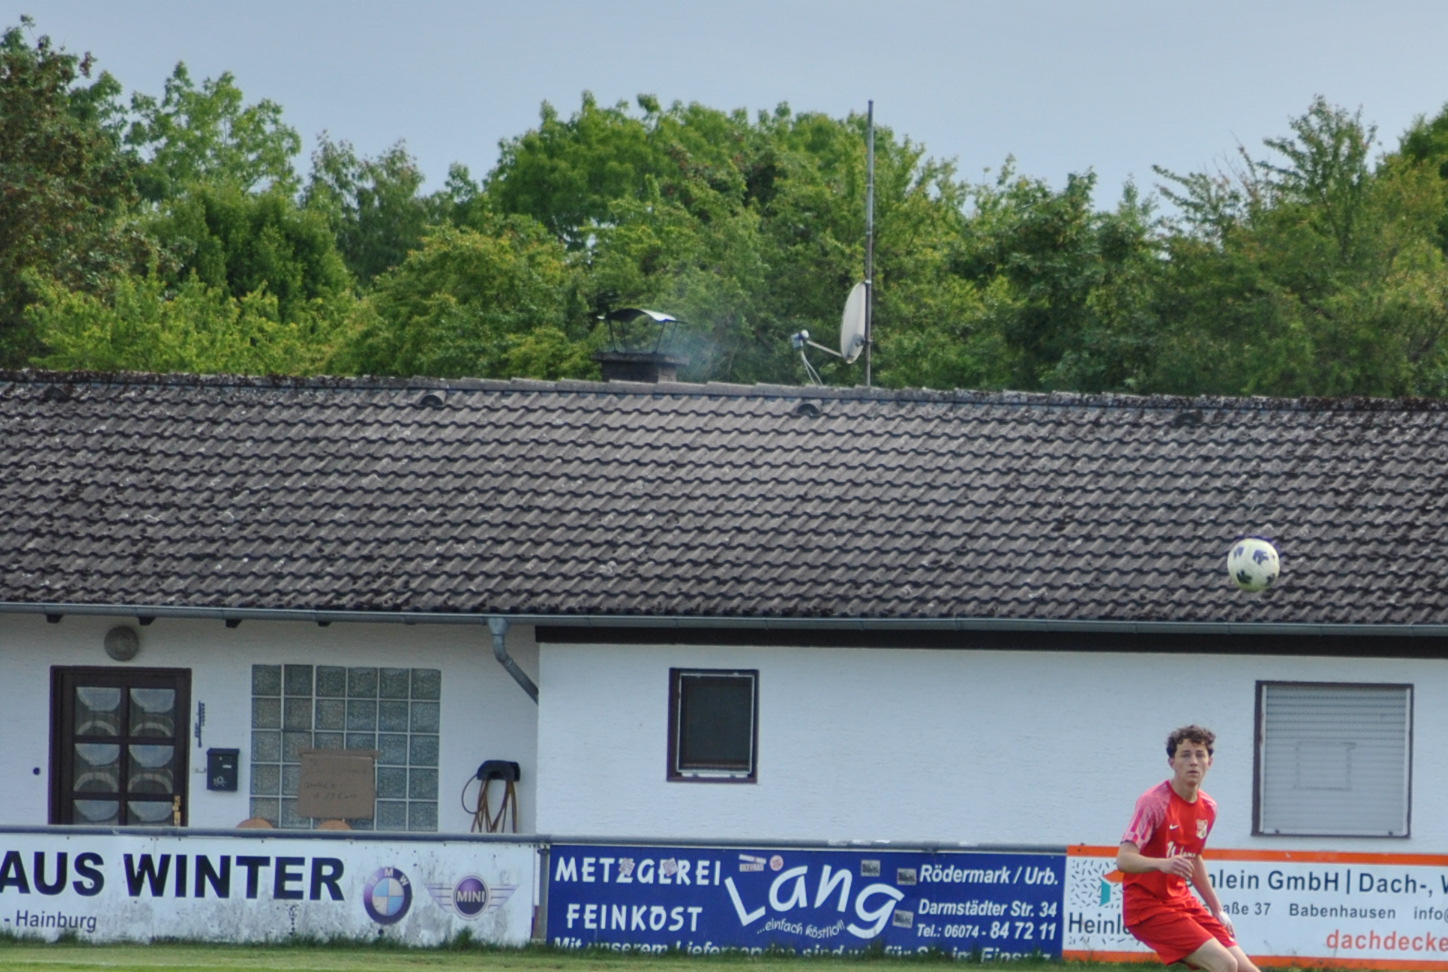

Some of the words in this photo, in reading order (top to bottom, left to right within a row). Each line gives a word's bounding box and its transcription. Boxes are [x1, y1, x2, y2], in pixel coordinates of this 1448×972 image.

[0, 850, 105, 896] AUS
[123, 853, 345, 900] WINTER
[554, 856, 722, 886] METZGEREI
[919, 864, 1011, 884] Rödermark
[1024, 866, 1059, 886] Urb.
[1268, 870, 1339, 892] GmbH
[1359, 872, 1434, 898] Dach-,
[456, 890, 487, 904] MINI
[724, 864, 906, 940] Lang
[917, 899, 1008, 917] Darmstädter
[1010, 901, 1035, 918] Str.
[1039, 902, 1058, 918] 34
[16, 909, 98, 934] Hainburg
[566, 903, 703, 932] FEINKOST
[1254, 902, 1272, 916] 37
[1289, 903, 1397, 920] Babenhausen
[917, 924, 942, 938] Tel.:
[944, 925, 980, 939] 06074
[989, 921, 1010, 940] 84
[1014, 922, 1035, 940] 72
[1038, 922, 1057, 941] 11
[1068, 912, 1131, 935] Heinl
